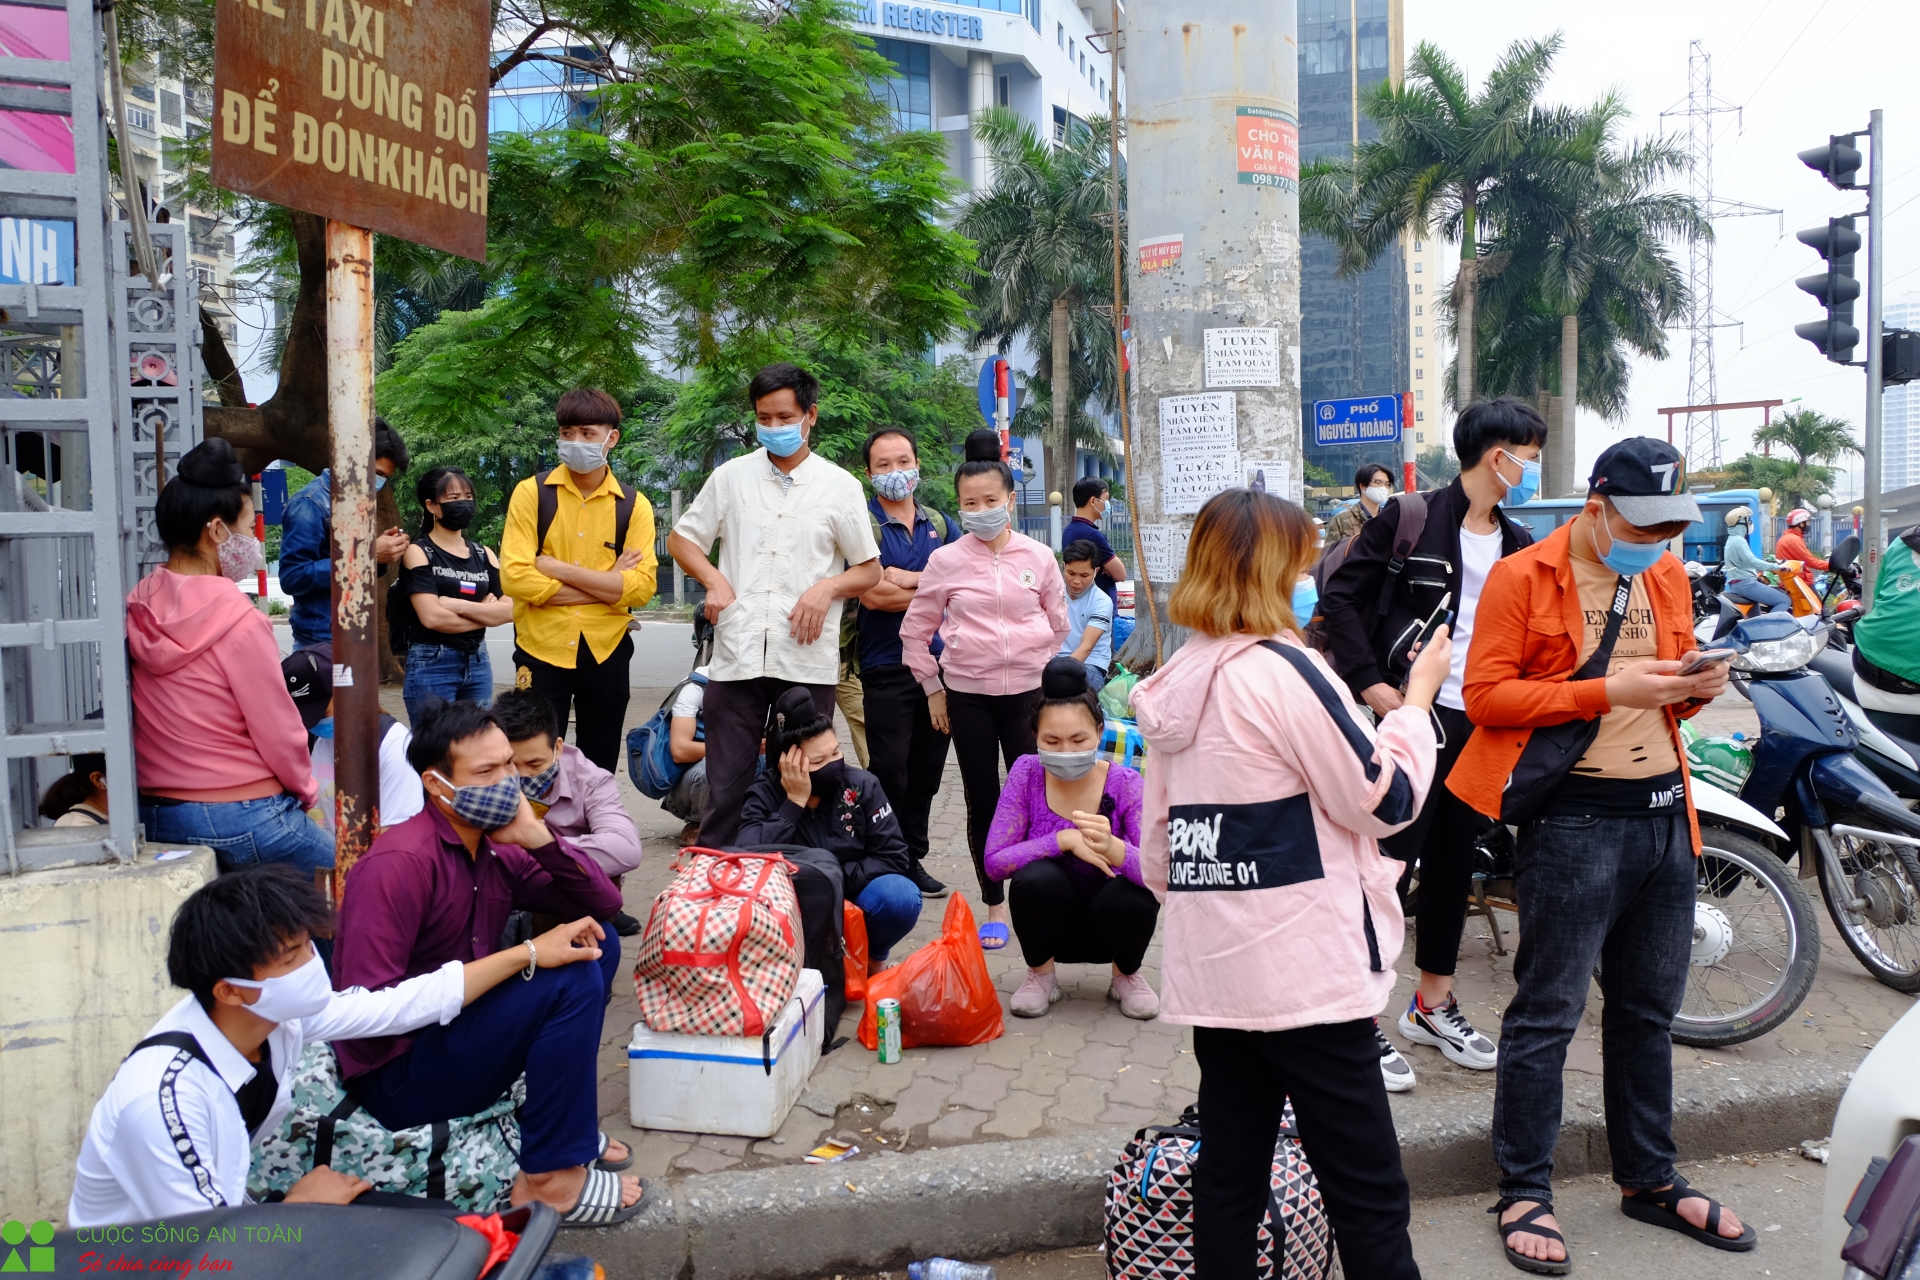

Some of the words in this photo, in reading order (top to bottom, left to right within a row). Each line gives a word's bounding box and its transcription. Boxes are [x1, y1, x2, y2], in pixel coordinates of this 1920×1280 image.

[883, 2, 983, 41] REGISTER
[322, 47, 423, 133] DỪNG
[434, 88, 477, 149] ĐỖ
[221, 78, 280, 156] ĐỂ
[1247, 129, 1279, 144] CHO
[1240, 144, 1273, 161] VĂN
[1252, 173, 1273, 186] 098
[1273, 176, 1289, 188] 777
[1350, 400, 1379, 415] PHỐ
[1318, 417, 1358, 441] NGUYỄN
[1359, 417, 1394, 438] HOÀNG
[1650, 462, 1676, 492] 7
[1612, 585, 1629, 616] 1988
[872, 802, 892, 824] FILA
[1236, 860, 1259, 885] 01
[1733, 1019, 1752, 1030] TYRE
